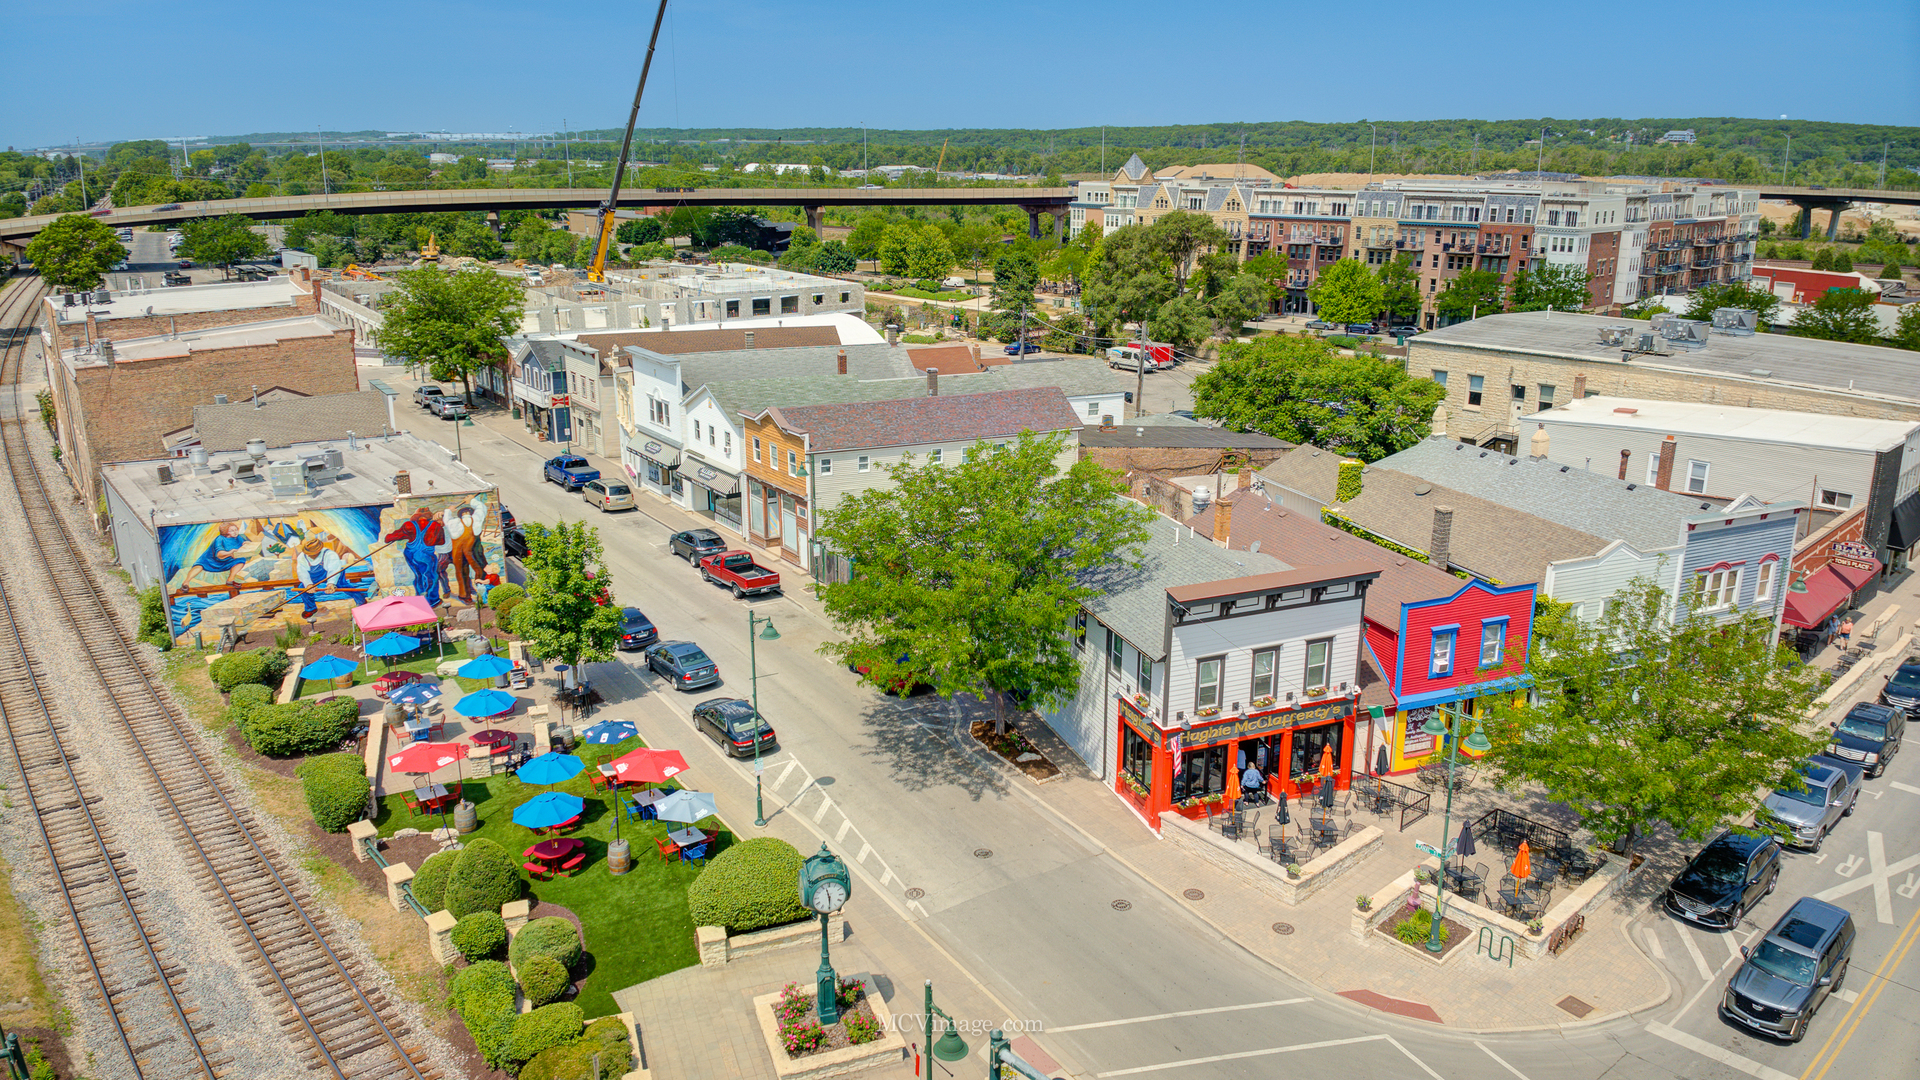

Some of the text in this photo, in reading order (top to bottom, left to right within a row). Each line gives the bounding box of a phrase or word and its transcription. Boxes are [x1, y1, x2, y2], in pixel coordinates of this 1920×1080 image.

[1835, 544, 1873, 558] BLATZ
[1835, 558, 1870, 570] TOM'S PLACE
[1121, 701, 1160, 742] Hughie's
[1180, 704, 1341, 743] Hughie McClafferty's
